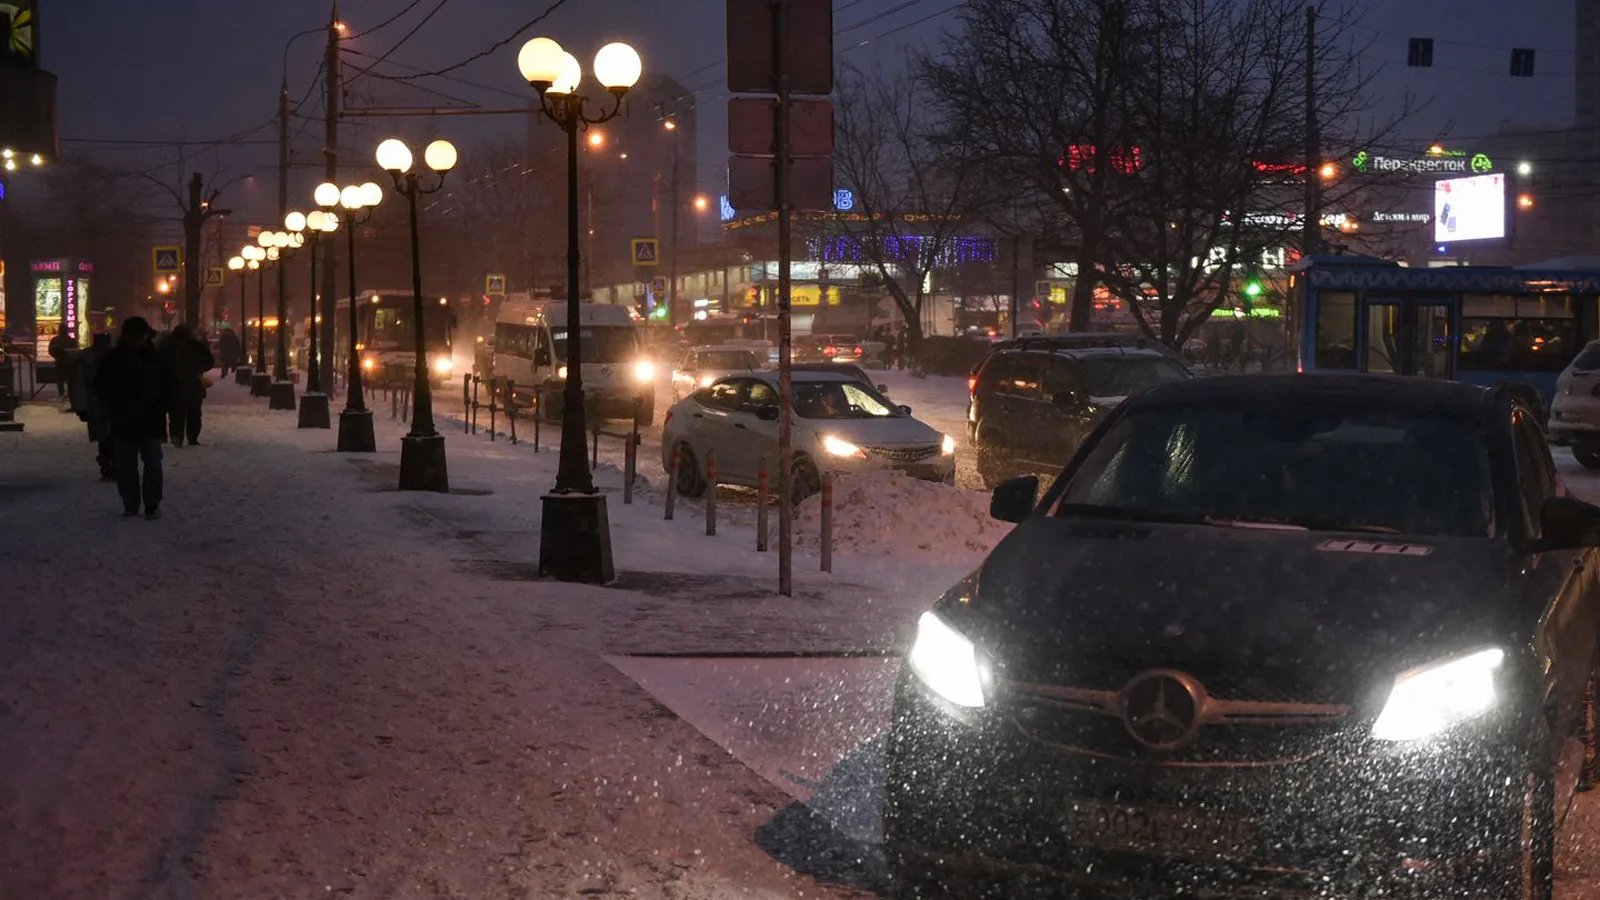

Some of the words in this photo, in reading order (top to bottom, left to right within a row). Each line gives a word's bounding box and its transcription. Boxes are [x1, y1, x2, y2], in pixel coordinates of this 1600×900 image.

[1373, 156, 1466, 173] Перекресток
[1411, 213, 1430, 224] мир
[67, 280, 76, 328] ТОРГОВЫЙ
